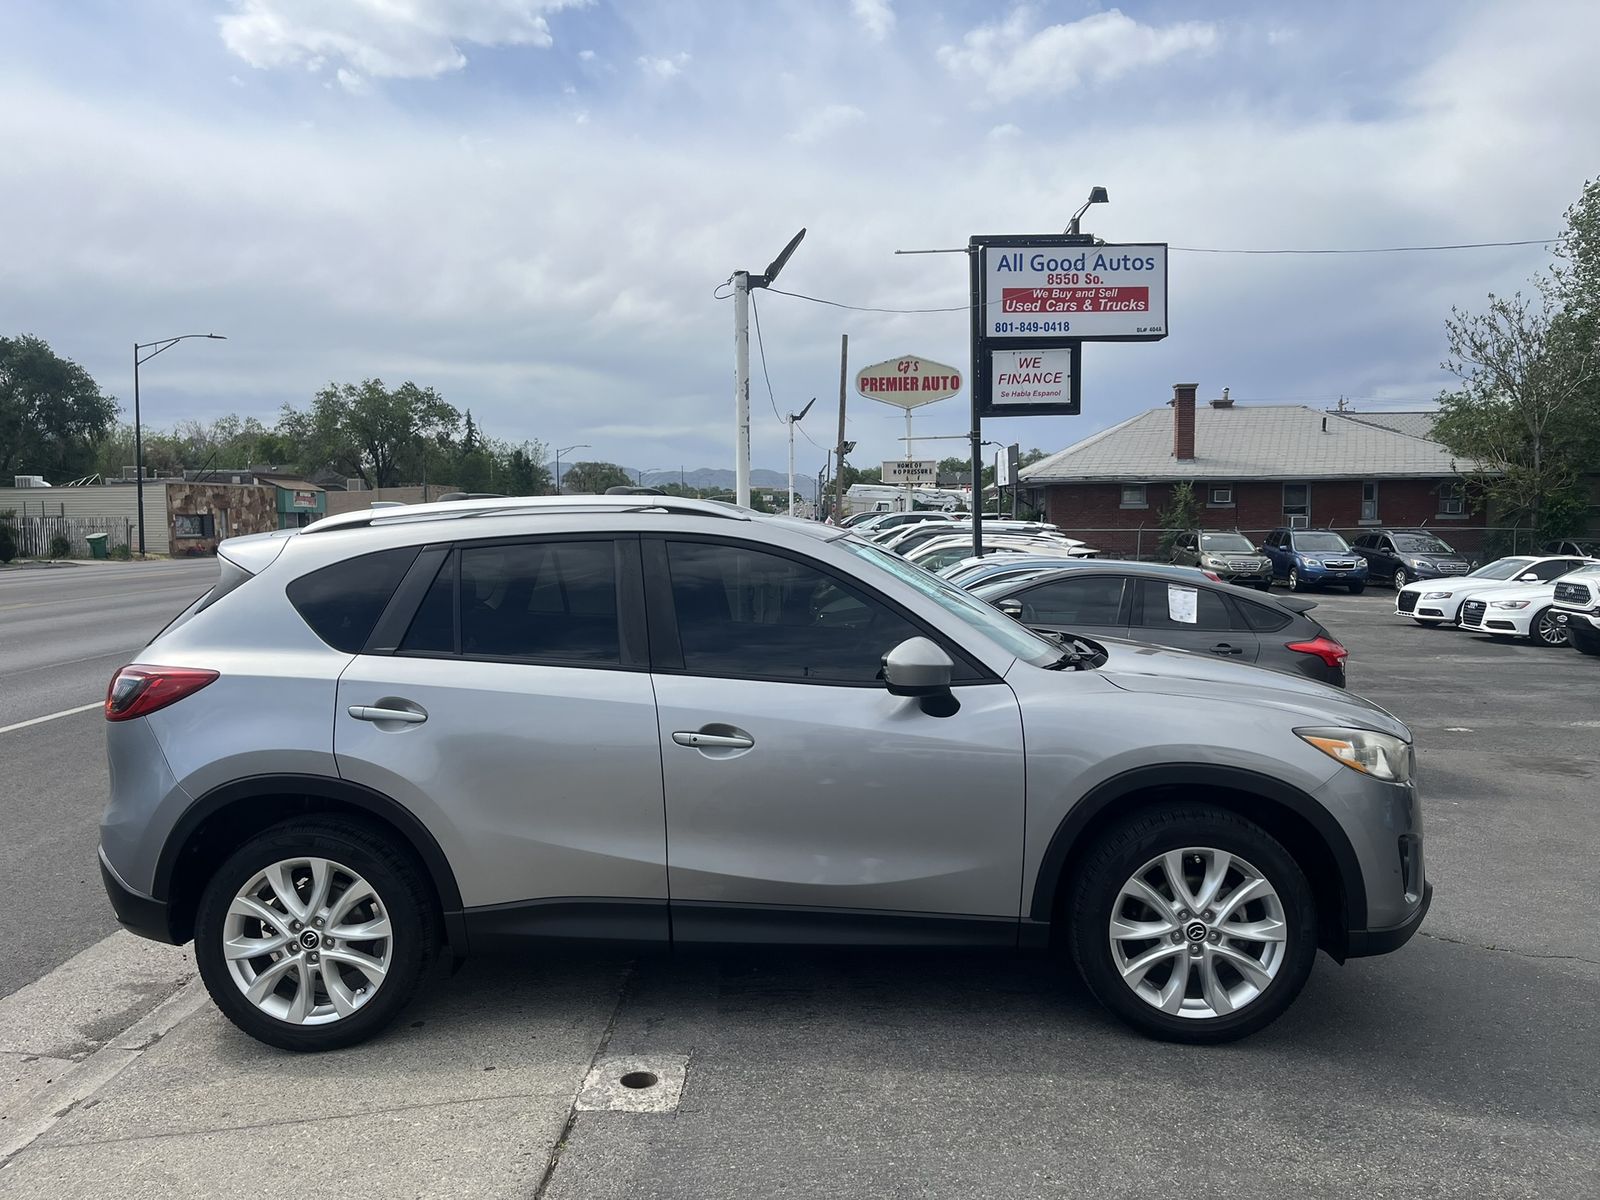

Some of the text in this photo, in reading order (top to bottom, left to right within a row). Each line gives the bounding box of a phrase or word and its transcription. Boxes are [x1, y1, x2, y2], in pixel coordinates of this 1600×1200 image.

[997, 253, 1155, 272] All Good Autos
[1047, 273, 1104, 285] 8550 So.
[1033, 288, 1118, 300] We Buy and Sell
[1006, 299, 1145, 312] Used Cars & Trucks
[995, 321, 1070, 333] 801-849-0418
[1018, 357, 1042, 369] WE
[860, 375, 960, 392] PREMIER AUTO
[998, 372, 1063, 385] FINANCE
[1032, 389, 1061, 398] Espanol
